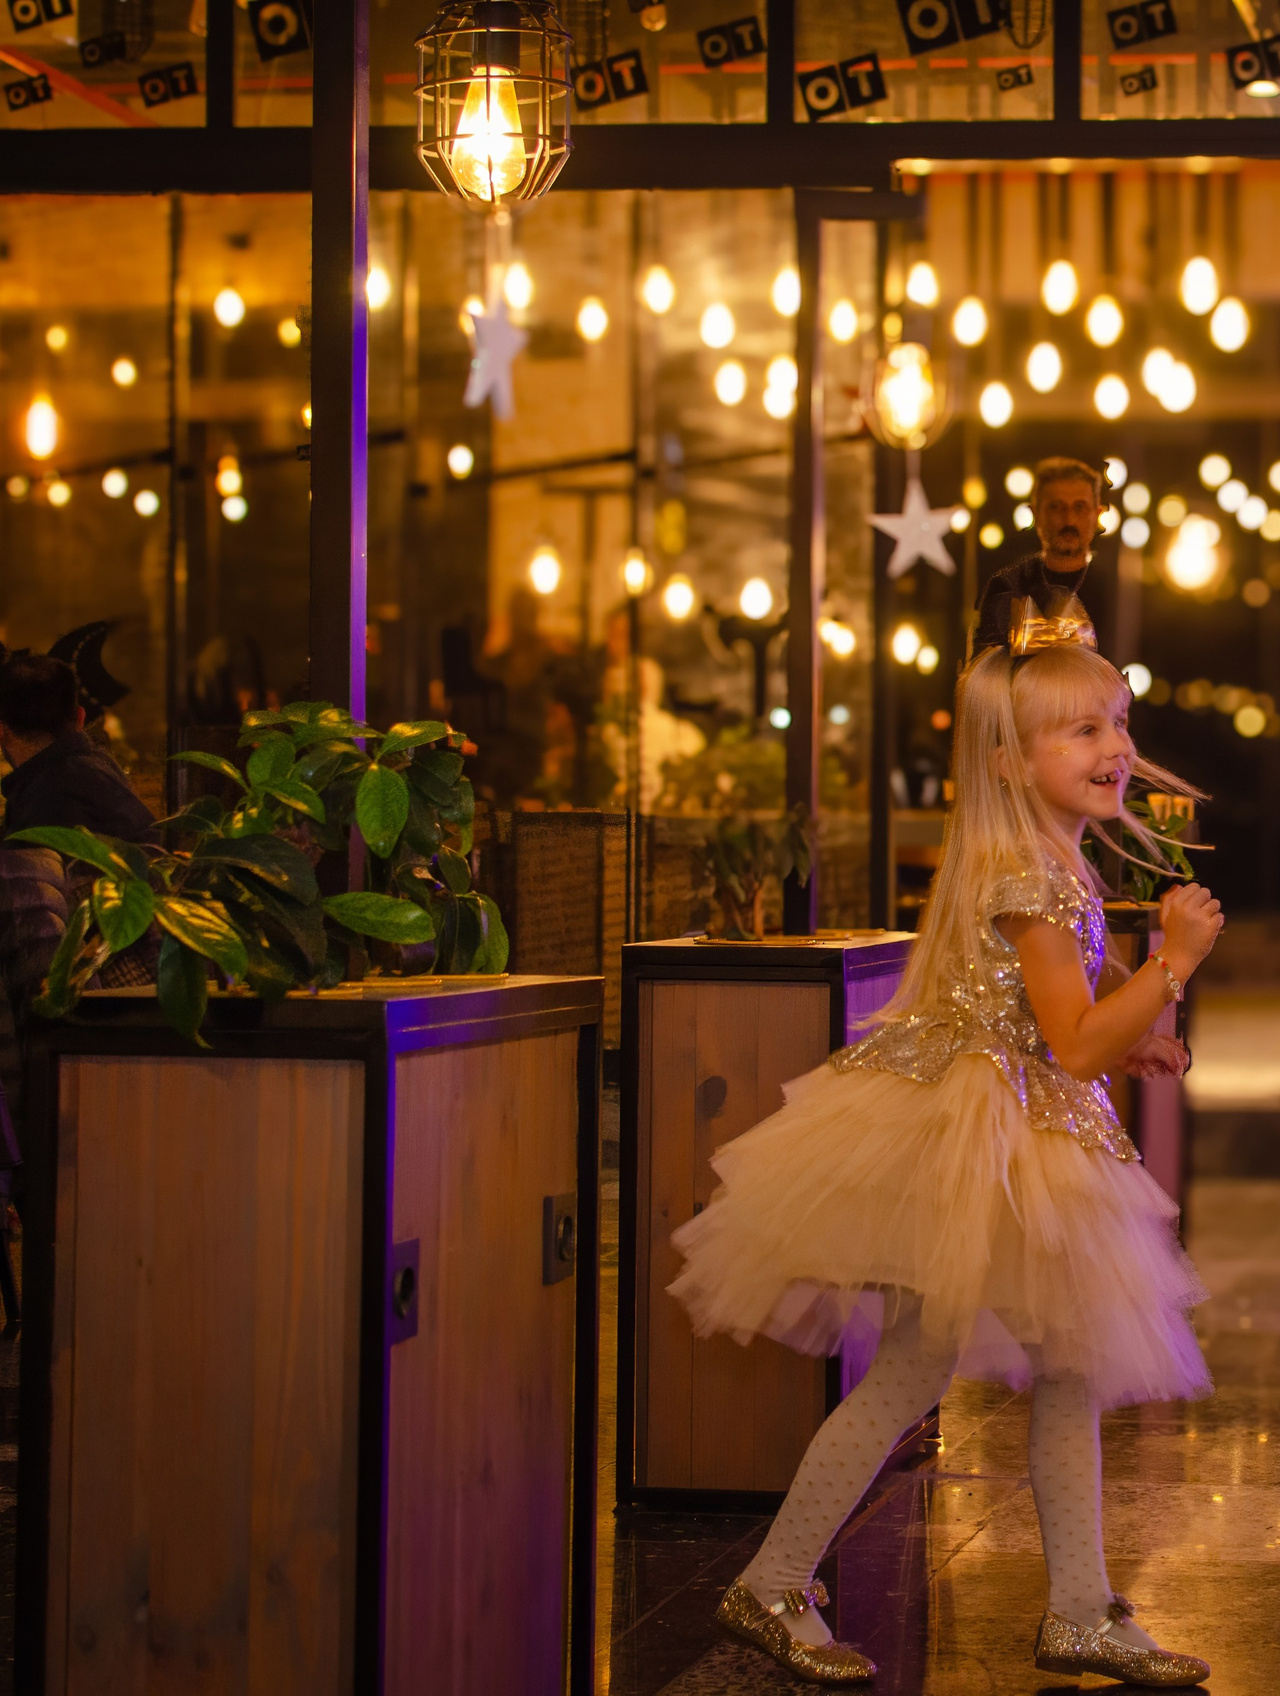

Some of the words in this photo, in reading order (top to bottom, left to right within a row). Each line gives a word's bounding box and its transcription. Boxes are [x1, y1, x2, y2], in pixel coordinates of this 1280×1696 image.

[1113, 3, 1167, 41] OT
[703, 23, 755, 60] OT
[7, 79, 46, 106] OT
[144, 68, 189, 99] OT
[575, 57, 638, 102] OT
[805, 60, 874, 111] OT
[1000, 66, 1030, 89] OT
